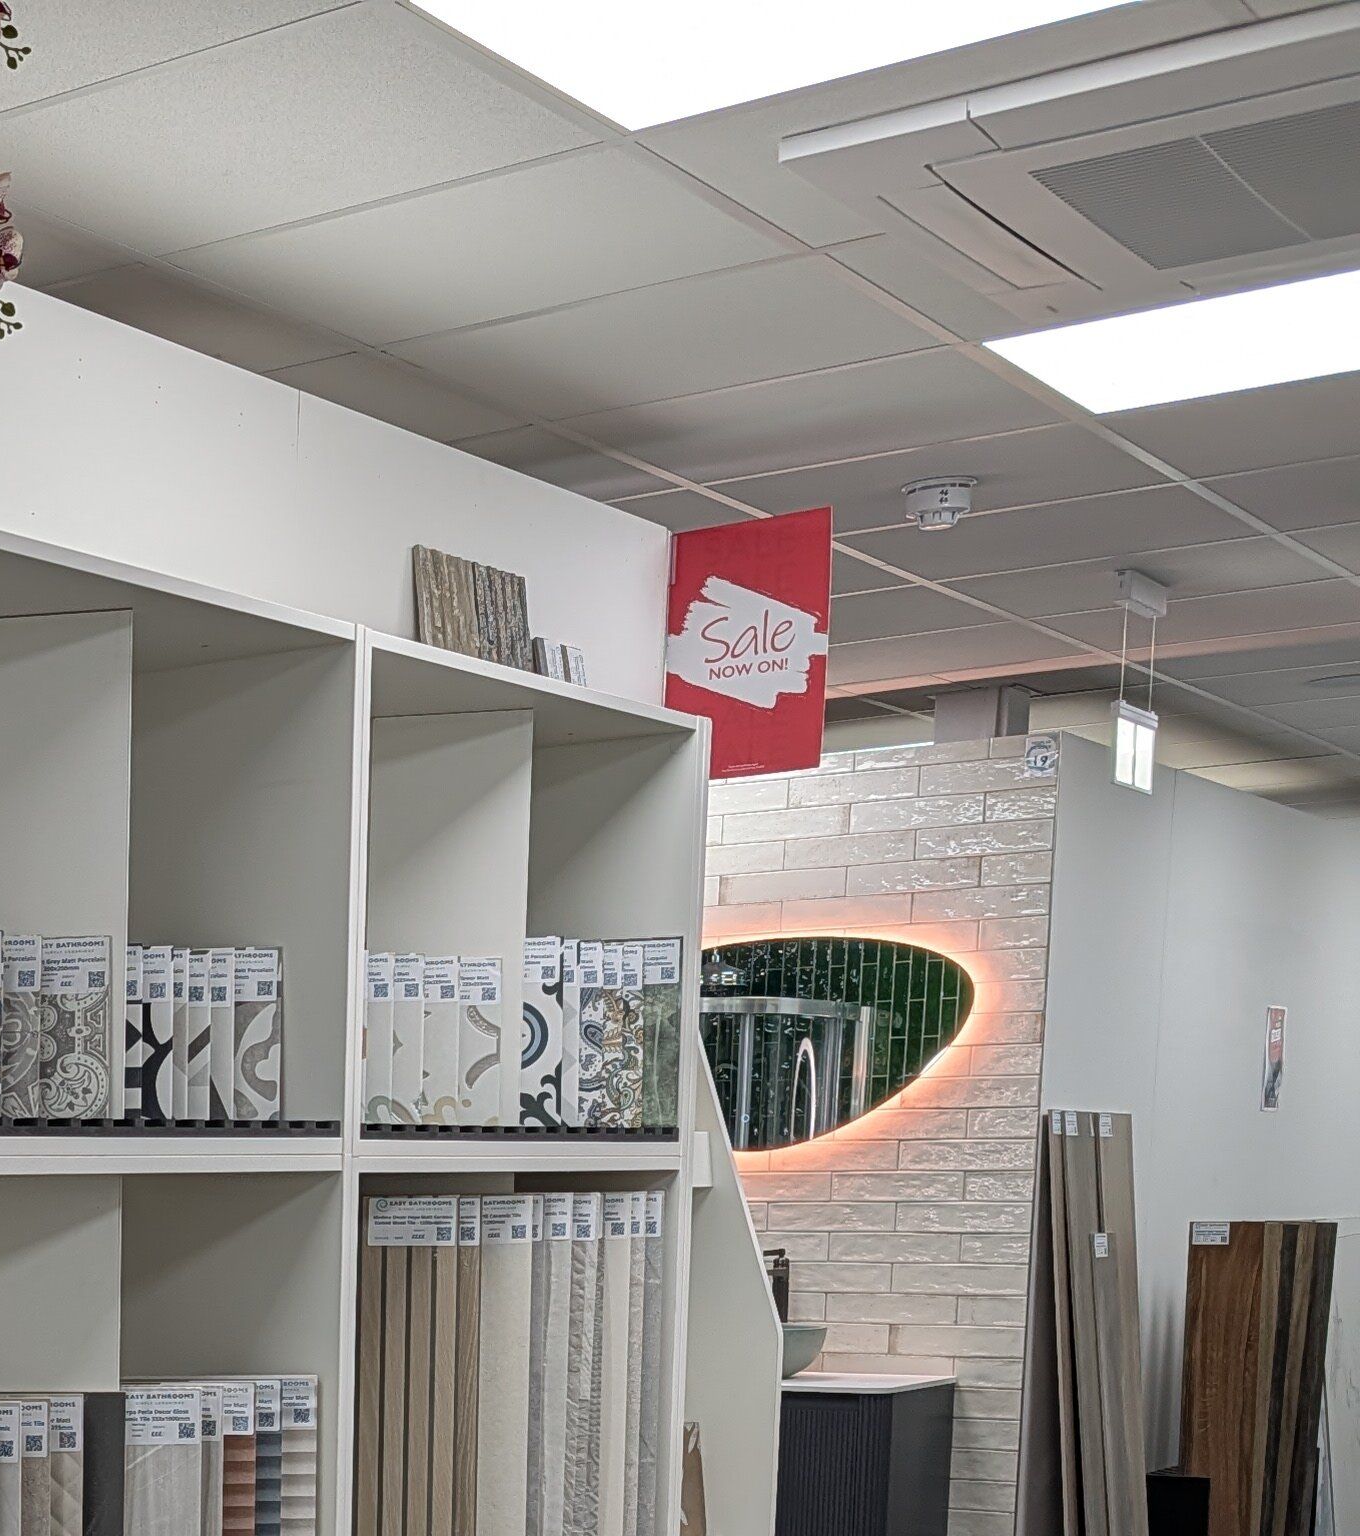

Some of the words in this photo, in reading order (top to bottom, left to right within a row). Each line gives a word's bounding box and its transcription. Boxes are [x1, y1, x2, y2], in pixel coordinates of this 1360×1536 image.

[700, 609, 796, 664] Sale
[709, 663, 753, 680] NOW
[758, 658, 788, 674] ON!
